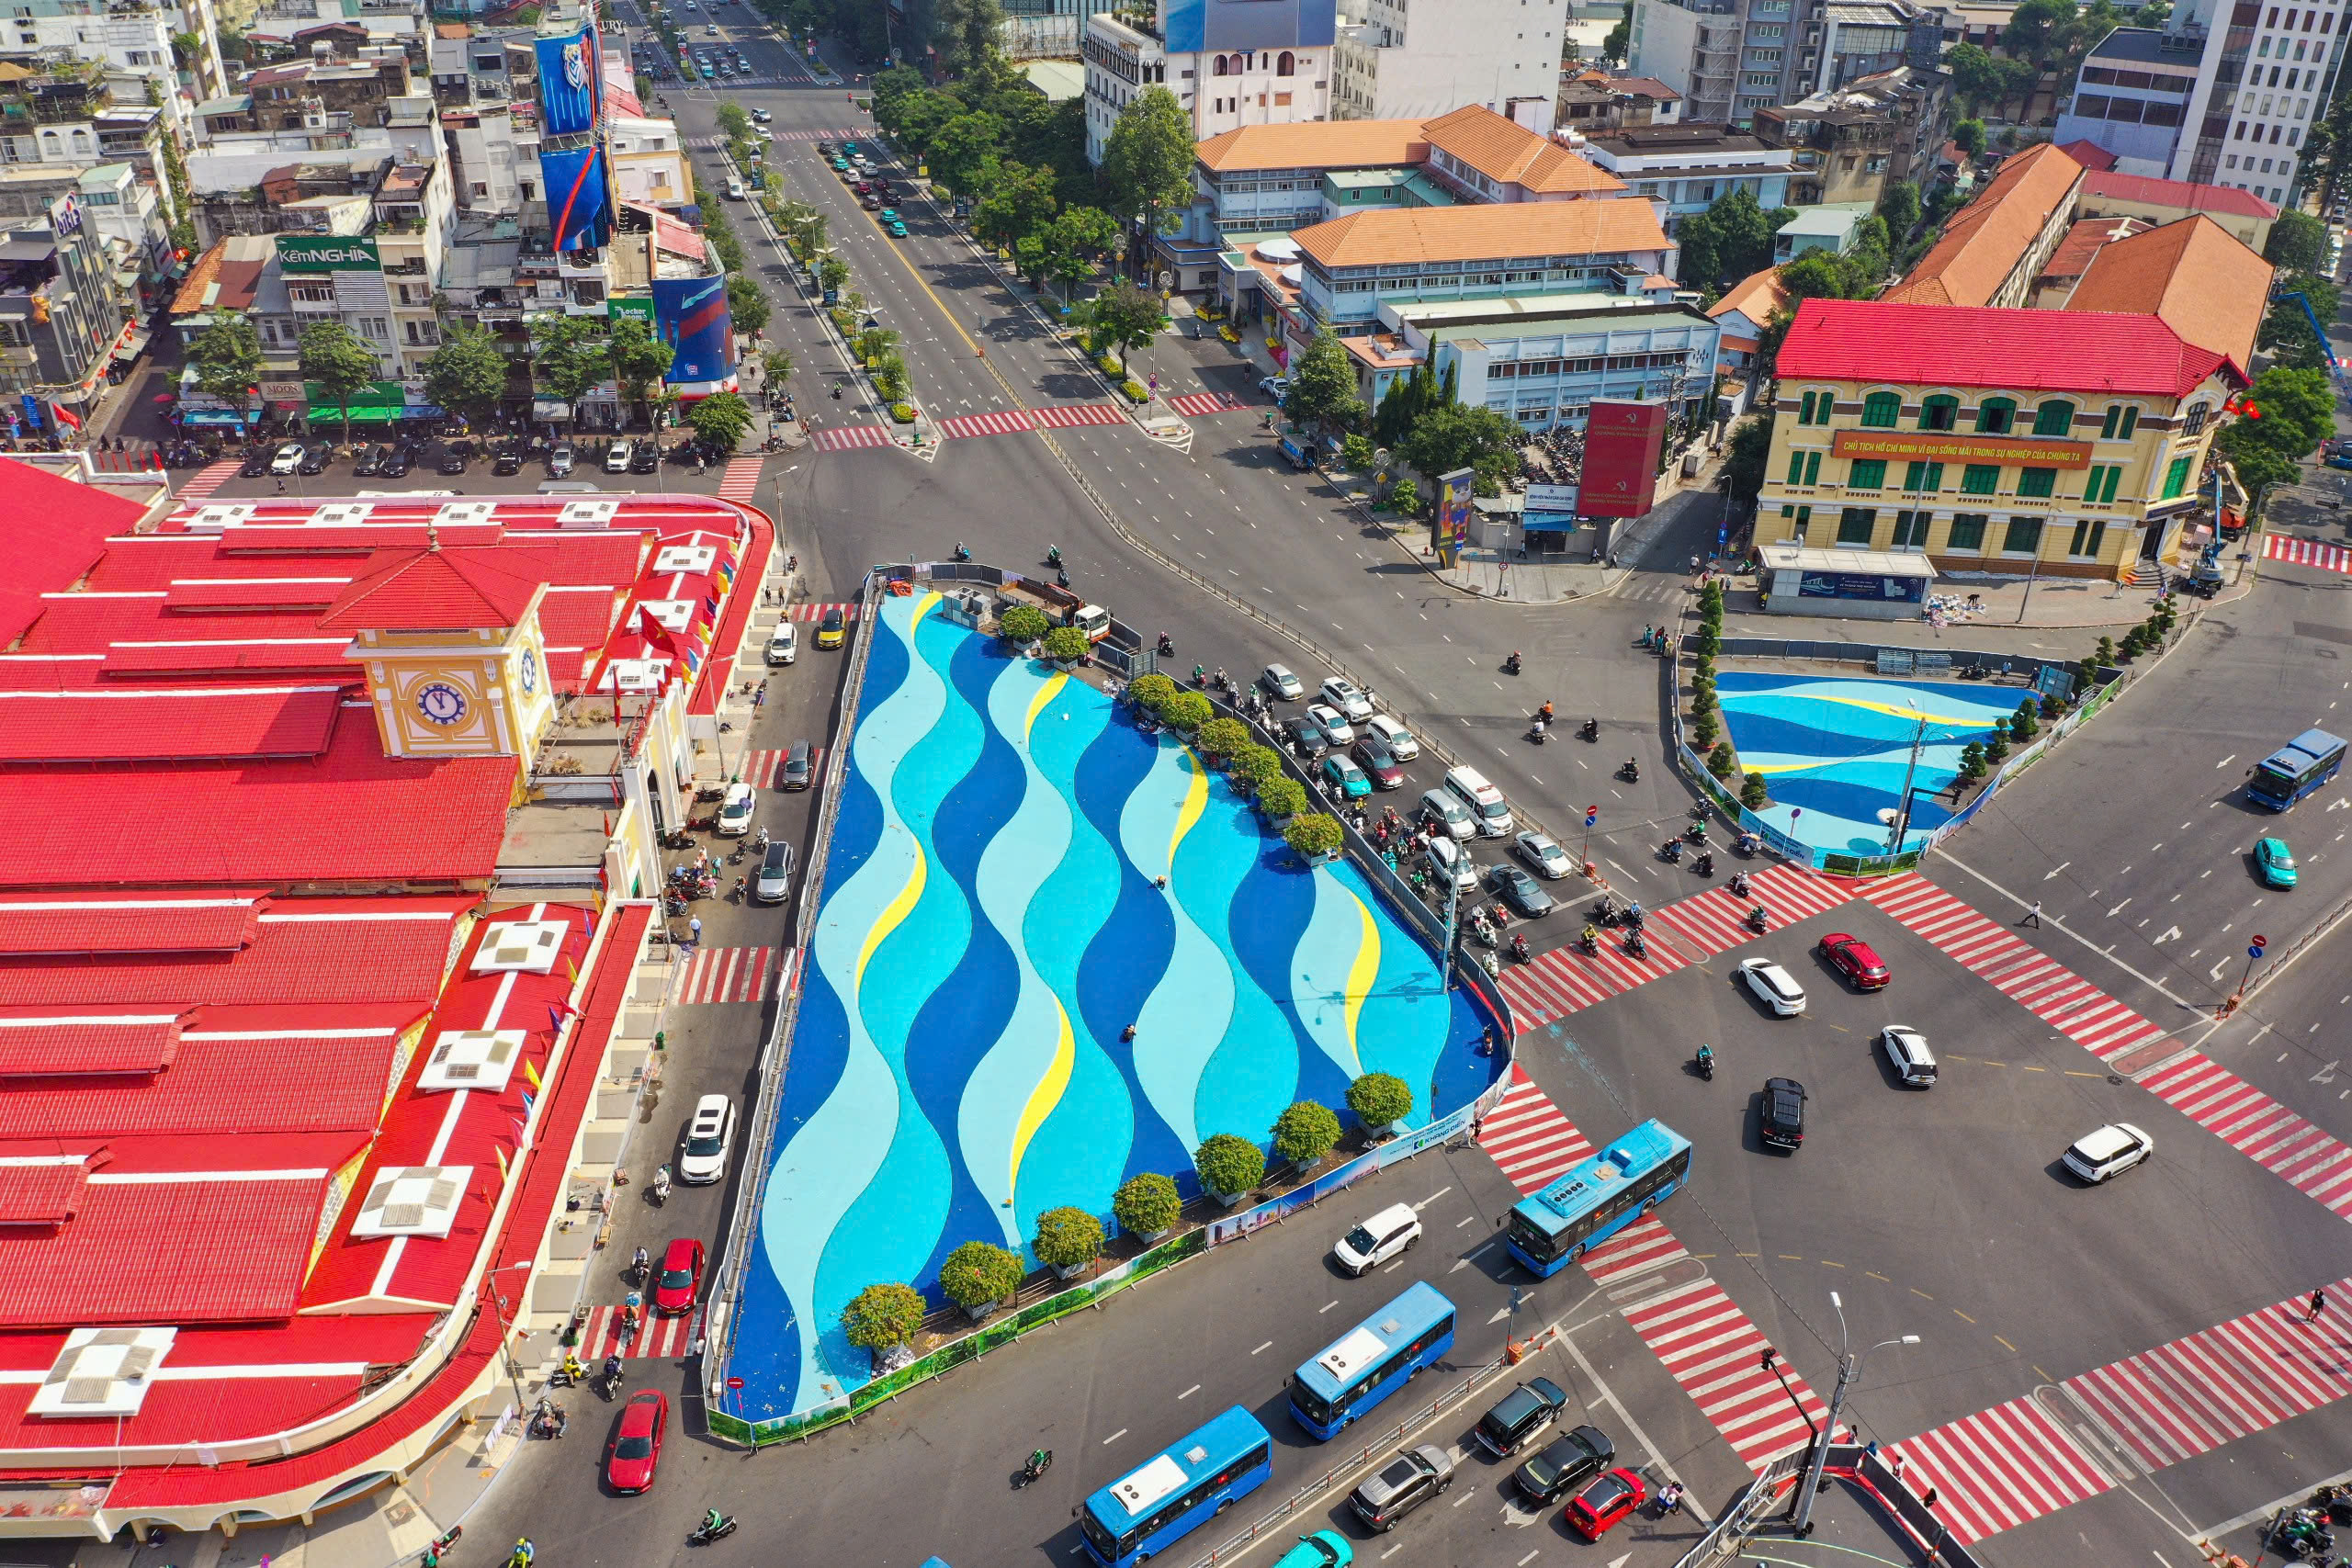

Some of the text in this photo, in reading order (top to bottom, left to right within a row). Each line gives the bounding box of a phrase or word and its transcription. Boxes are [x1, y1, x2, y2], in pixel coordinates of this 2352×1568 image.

[1844, 440, 1859, 451] CHỦ
[1860, 442, 1875, 453] TỊCH
[1875, 441, 1886, 452] HỒ
[1886, 442, 1898, 453] CHÍ
[1898, 444, 1917, 454] MINH
[1939, 444, 1958, 456] SỐNG
[1973, 447, 1996, 457] TRONG
[2031, 448, 2046, 460] CỦA
[2071, 452, 2081, 462] TA
